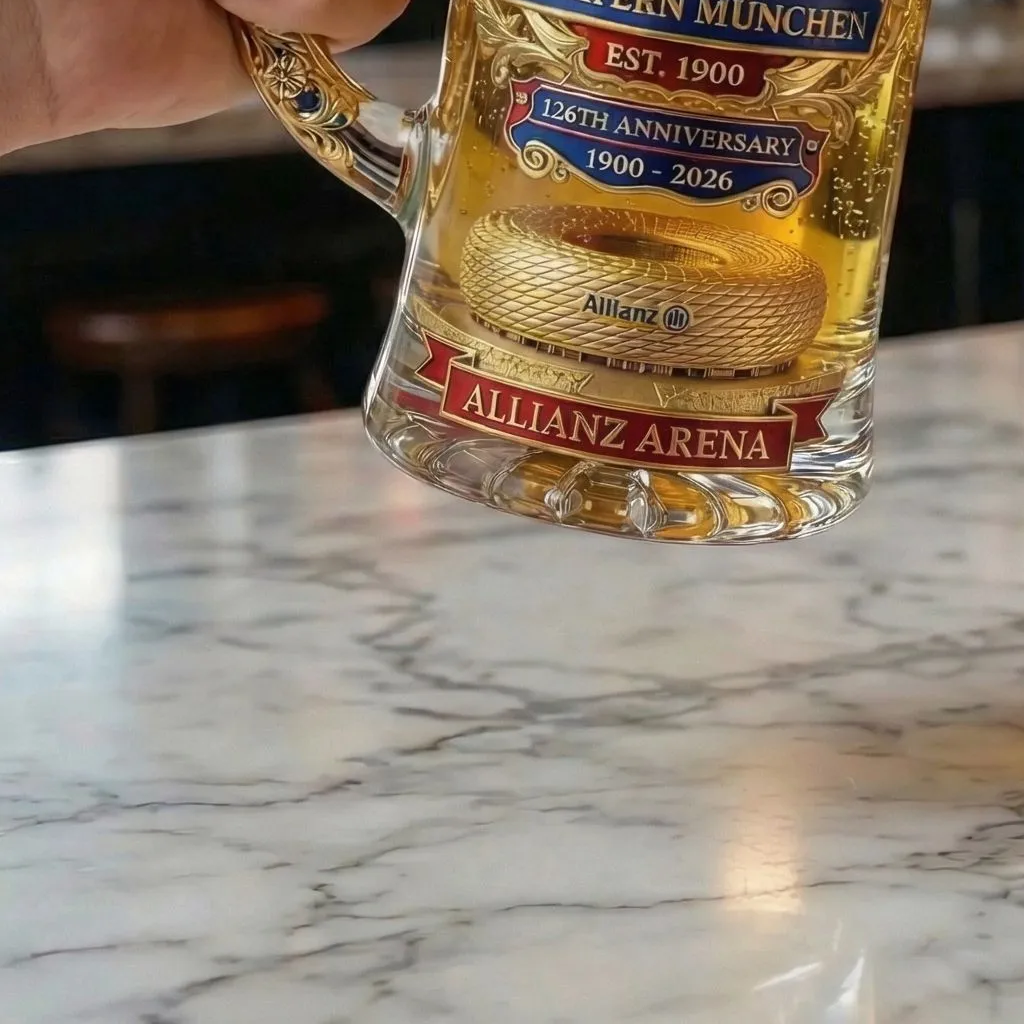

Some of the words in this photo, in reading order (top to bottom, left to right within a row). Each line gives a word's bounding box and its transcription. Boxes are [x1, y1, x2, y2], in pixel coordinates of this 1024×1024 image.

[604, 41, 666, 77] EST.
[676, 54, 746, 88] 1900
[541, 97, 610, 132] 126TH
[616, 117, 796, 158] ANNIVERSARY
[584, 147, 645, 180] 1900
[670, 163, 735, 193] 2026
[581, 293, 659, 325] Allianz
[462, 383, 629, 451] ALLIANZ
[634, 423, 771, 462] ARENA
